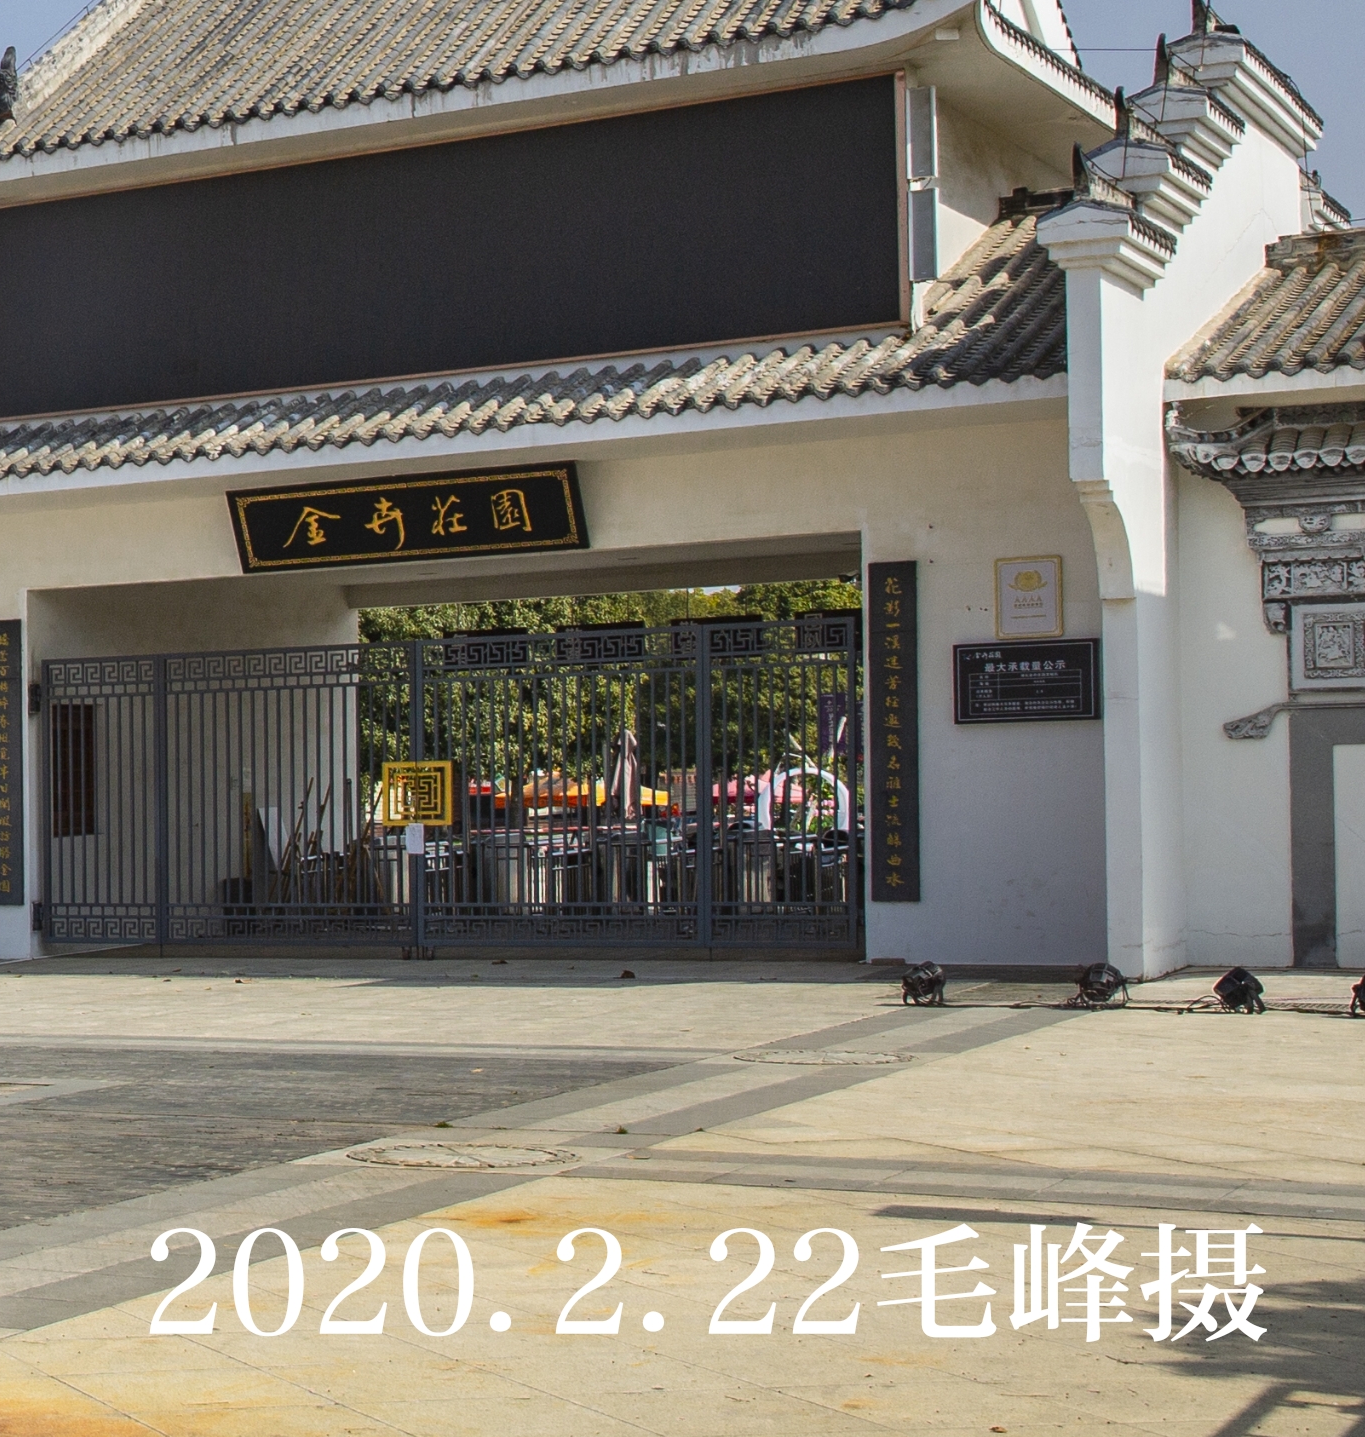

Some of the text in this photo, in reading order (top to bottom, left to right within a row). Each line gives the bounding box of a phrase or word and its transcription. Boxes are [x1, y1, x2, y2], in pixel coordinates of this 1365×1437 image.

[984, 659, 1067, 673] 最大承载量公示
